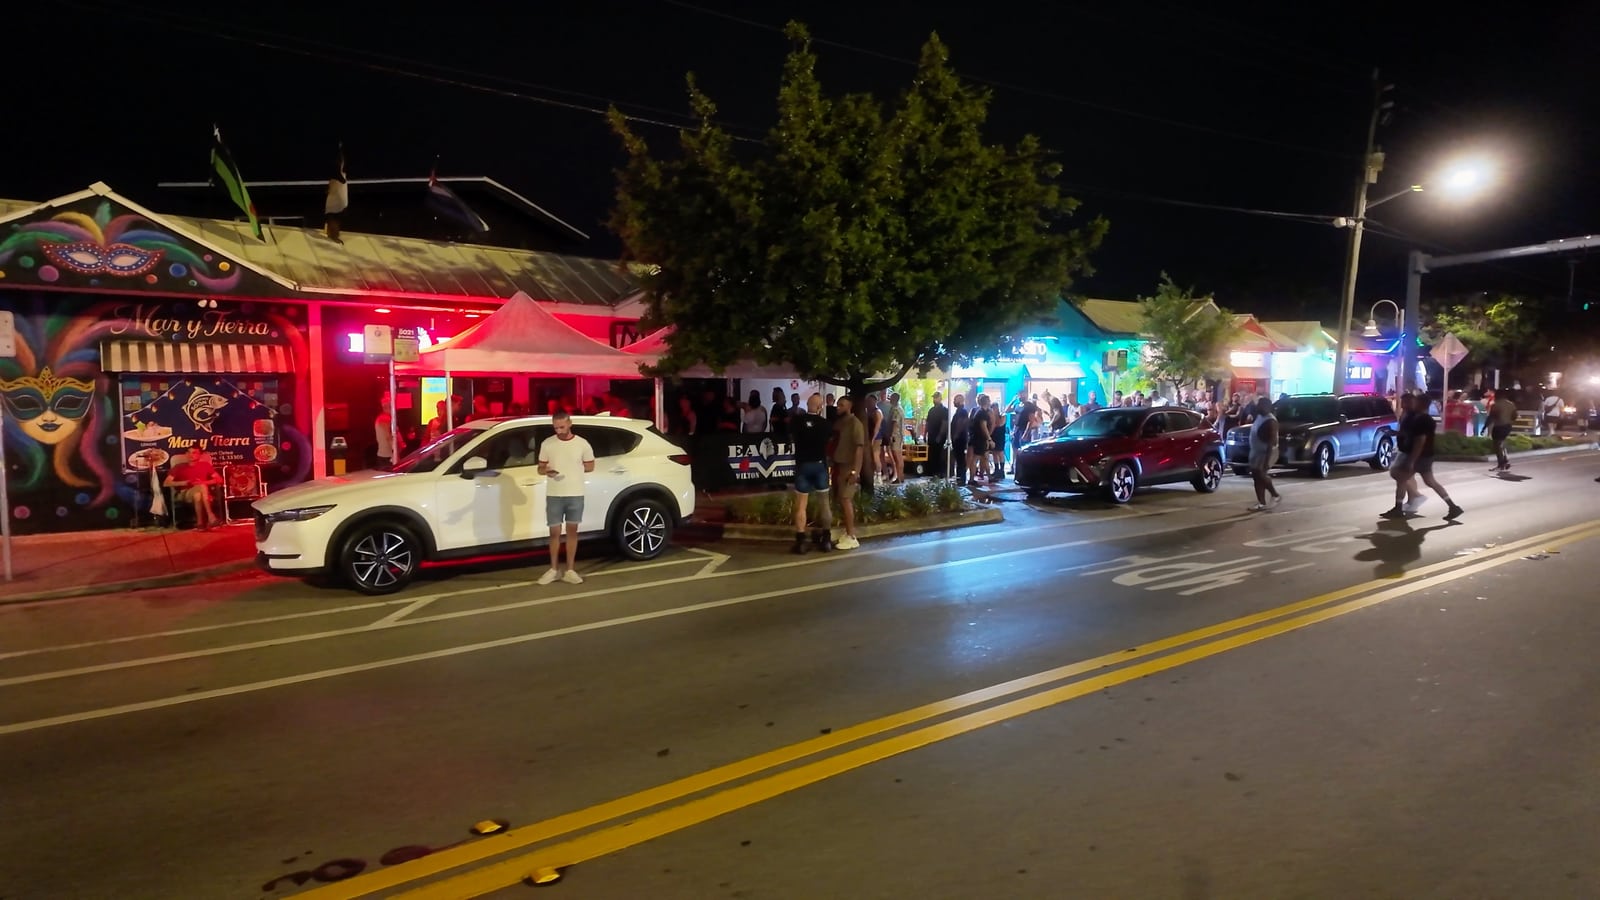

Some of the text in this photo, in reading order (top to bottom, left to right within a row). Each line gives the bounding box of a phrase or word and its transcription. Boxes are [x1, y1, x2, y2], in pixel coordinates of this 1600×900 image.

[110, 304, 270, 339] Mar y Tierra
[168, 436, 197, 448] Mar
[200, 438, 208, 450] y
[210, 434, 250, 447] Tierra
[735, 470, 796, 480] WILTON MANOR
